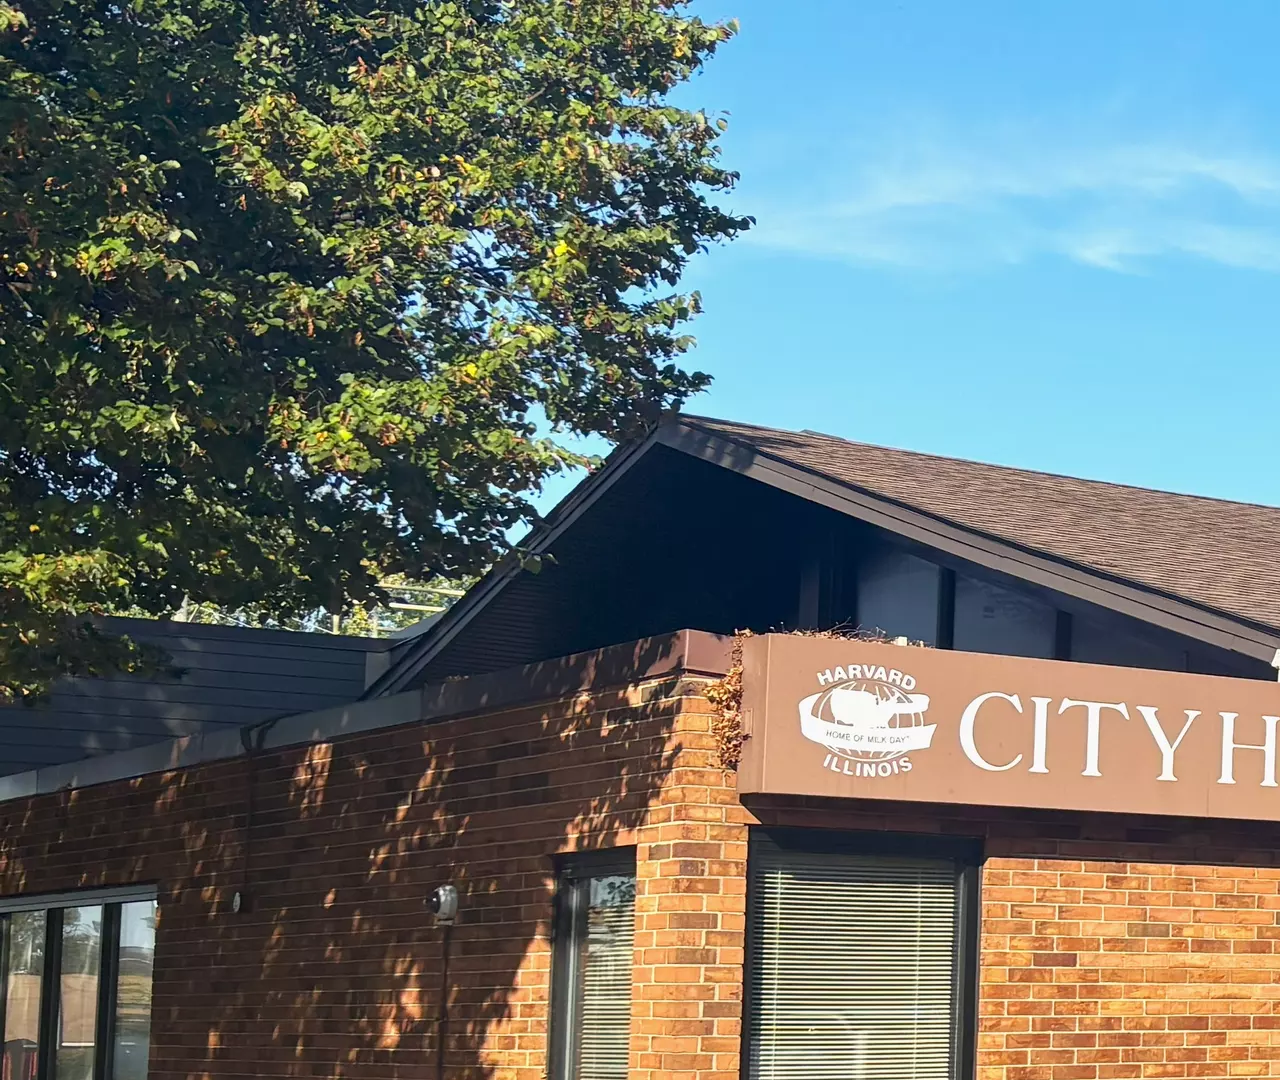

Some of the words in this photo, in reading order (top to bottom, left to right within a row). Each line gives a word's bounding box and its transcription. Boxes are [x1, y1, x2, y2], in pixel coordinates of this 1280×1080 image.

[816, 664, 916, 690] HARVARD
[825, 729, 851, 742] HOME
[853, 734, 865, 743] OF
[867, 735, 887, 744] MILK
[958, 691, 1202, 783] CITY
[823, 754, 913, 778] ILLINOIS
